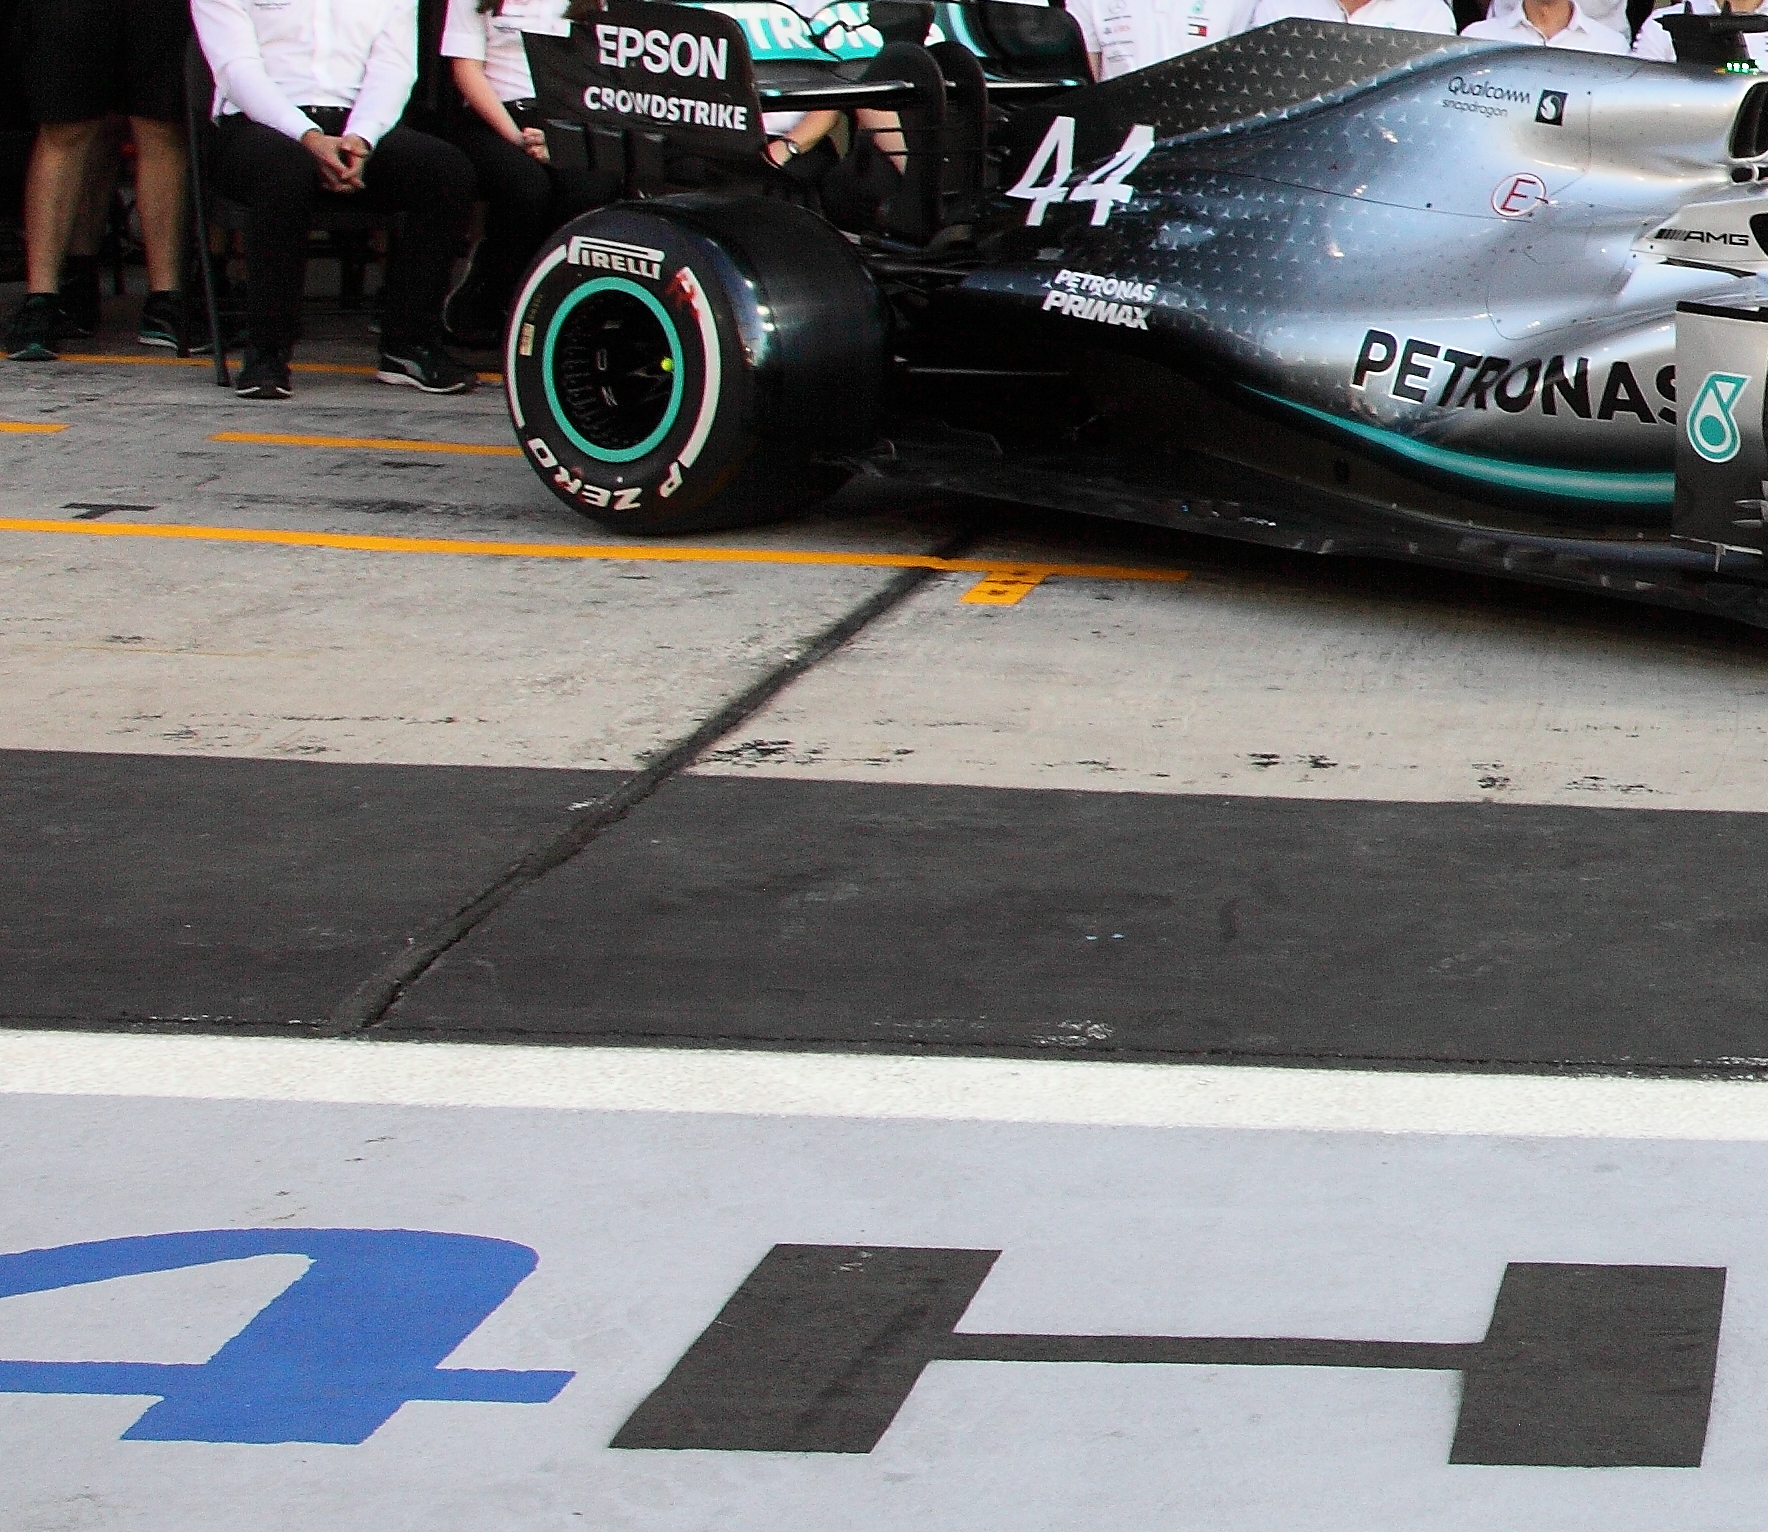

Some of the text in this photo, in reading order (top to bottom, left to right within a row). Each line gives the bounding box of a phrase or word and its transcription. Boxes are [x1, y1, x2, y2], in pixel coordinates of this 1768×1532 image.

[595, 22, 729, 81] EPSON
[584, 84, 748, 131] CROWDSTRIKE
[1441, 97, 1509, 119] snapdragon
[1447, 76, 1531, 104] Qualcomm
[1005, 115, 1156, 227] 44
[566, 234, 667, 280] PIRELLI
[1683, 230, 1750, 247] AMG
[1054, 268, 1157, 302] PETRONAS
[1041, 289, 1152, 331] PRIMAX
[1349, 327, 1677, 426] PETRONAS
[526, 437, 643, 511] ZERO
